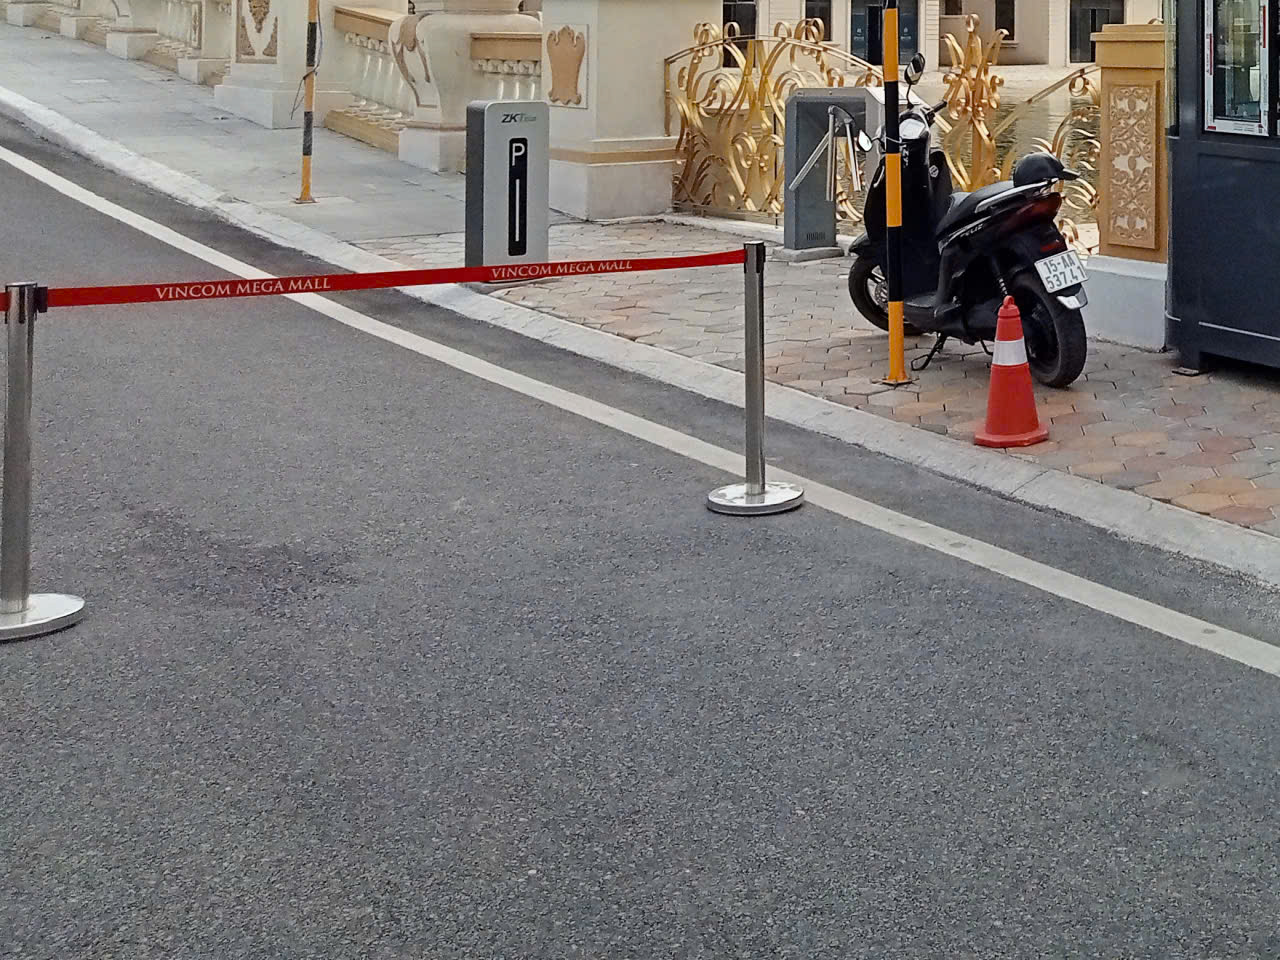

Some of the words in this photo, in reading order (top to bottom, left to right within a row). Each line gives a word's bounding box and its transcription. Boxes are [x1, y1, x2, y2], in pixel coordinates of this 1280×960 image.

[511, 142, 526, 167] P
[490, 265, 552, 279] VINCOM
[555, 262, 595, 275] MEGA
[597, 260, 633, 272] MALL
[1043, 253, 1076, 275] 15-AA
[155, 283, 231, 300] VINCOM
[235, 280, 284, 295] MEGA
[288, 277, 331, 291] MALL
[1045, 265, 1086, 290] 537.41
